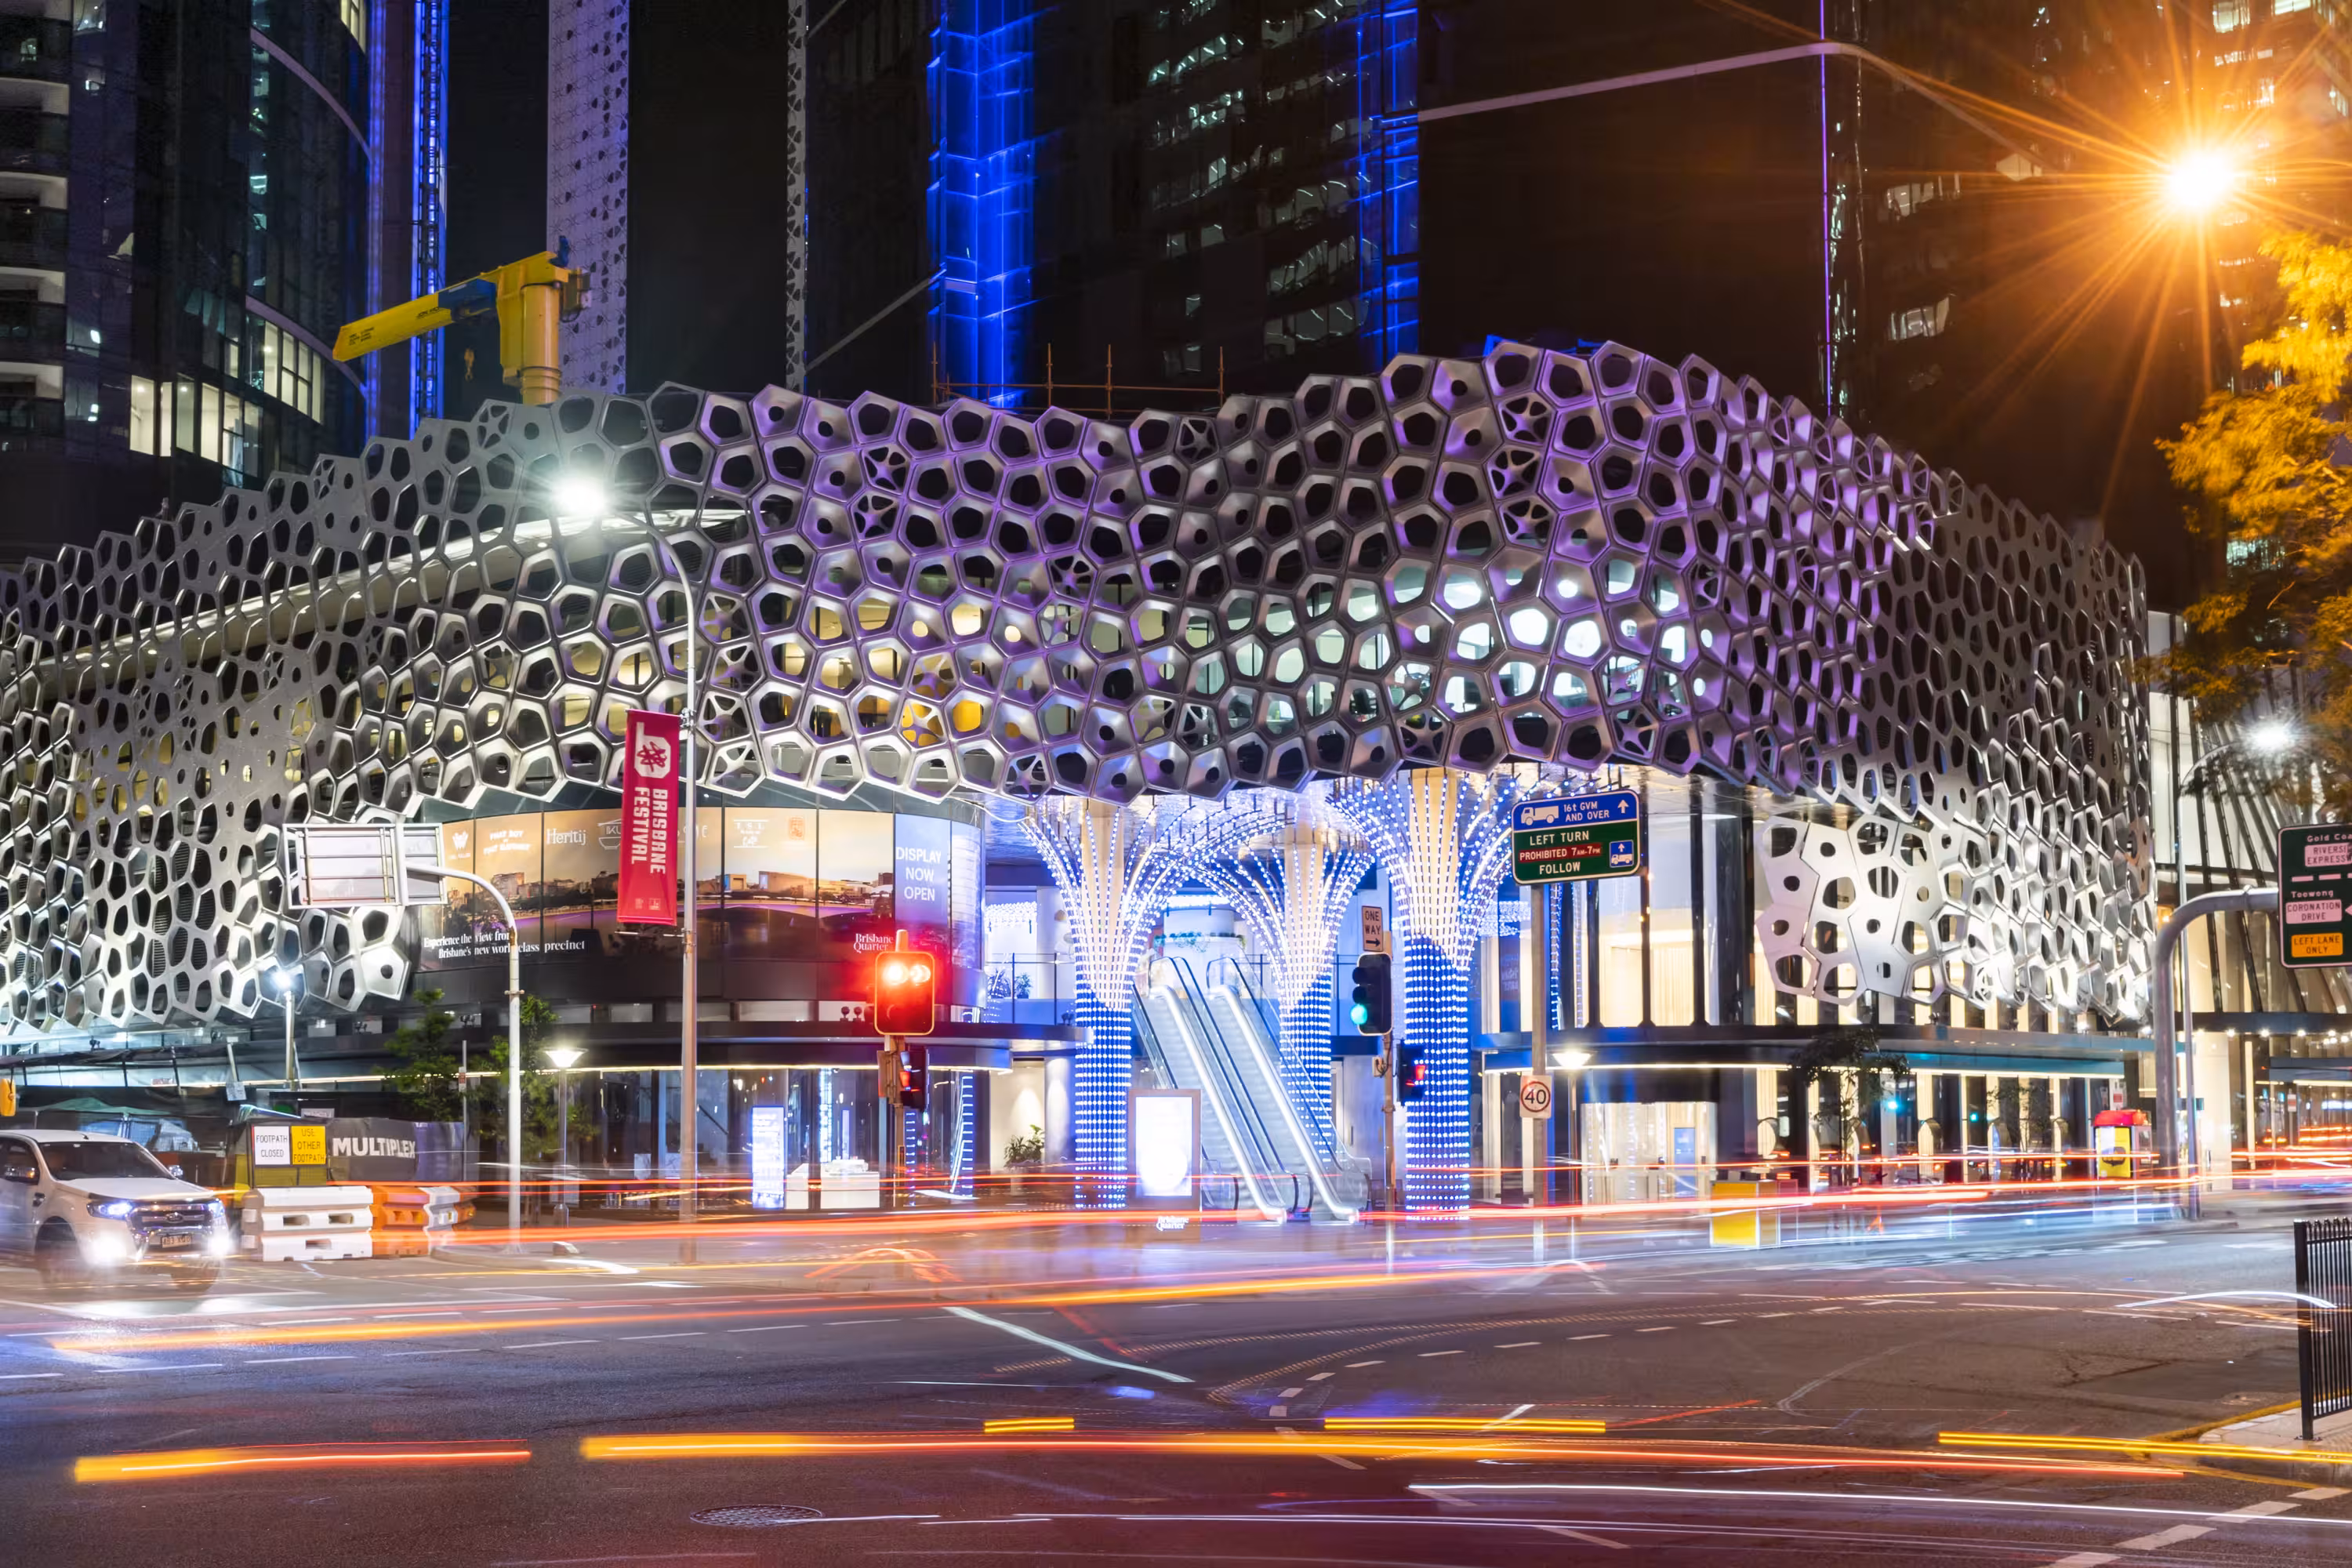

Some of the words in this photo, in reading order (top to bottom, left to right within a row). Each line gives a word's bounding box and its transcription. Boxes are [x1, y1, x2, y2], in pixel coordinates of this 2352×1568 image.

[1563, 803, 1577, 813] 16t
[1580, 801, 1598, 811] GVM
[1565, 813, 1584, 822] AND
[1587, 810, 1610, 819] OVER
[631, 786, 650, 865] FESTIVAL
[650, 788, 668, 875] BRISBANE
[1530, 833, 1555, 846] LEFT
[1560, 830, 1590, 843] TURN
[895, 847, 941, 863] DISPLAY
[1519, 848, 1567, 862] PROHIBITED
[1539, 862, 1581, 874] FOLLOW
[906, 867, 935, 882] NOW
[904, 886, 935, 901] OPEN
[2291, 890, 2334, 898] Toowong
[2287, 901, 2340, 913] CORONATION
[1365, 910, 1380, 921] ONE
[2301, 912, 2326, 921] DRIVE
[1365, 925, 1381, 935] WAY
[423, 936, 460, 949] Experience
[460, 933, 472, 943] the
[475, 932, 493, 942] view
[855, 933, 894, 943] Brisbane
[2294, 936, 2315, 946] LEFT
[2318, 935, 2340, 945] LANE
[439, 946, 471, 959] Brisbane's
[474, 946, 490, 955] new
[492, 943, 510, 953] worl
[544, 940, 585, 953] precinct
[853, 942, 889, 954] Quarter
[2306, 946, 2328, 954] ONLY
[1524, 1088, 1546, 1105] 40
[256, 1134, 289, 1143] FOOTPATH
[301, 1128, 315, 1137] USE
[297, 1141, 321, 1150] OTHER
[332, 1137, 416, 1159] MULTIPLEX
[260, 1149, 285, 1158] CLOSED
[293, 1153, 326, 1163] FOOTPATH
